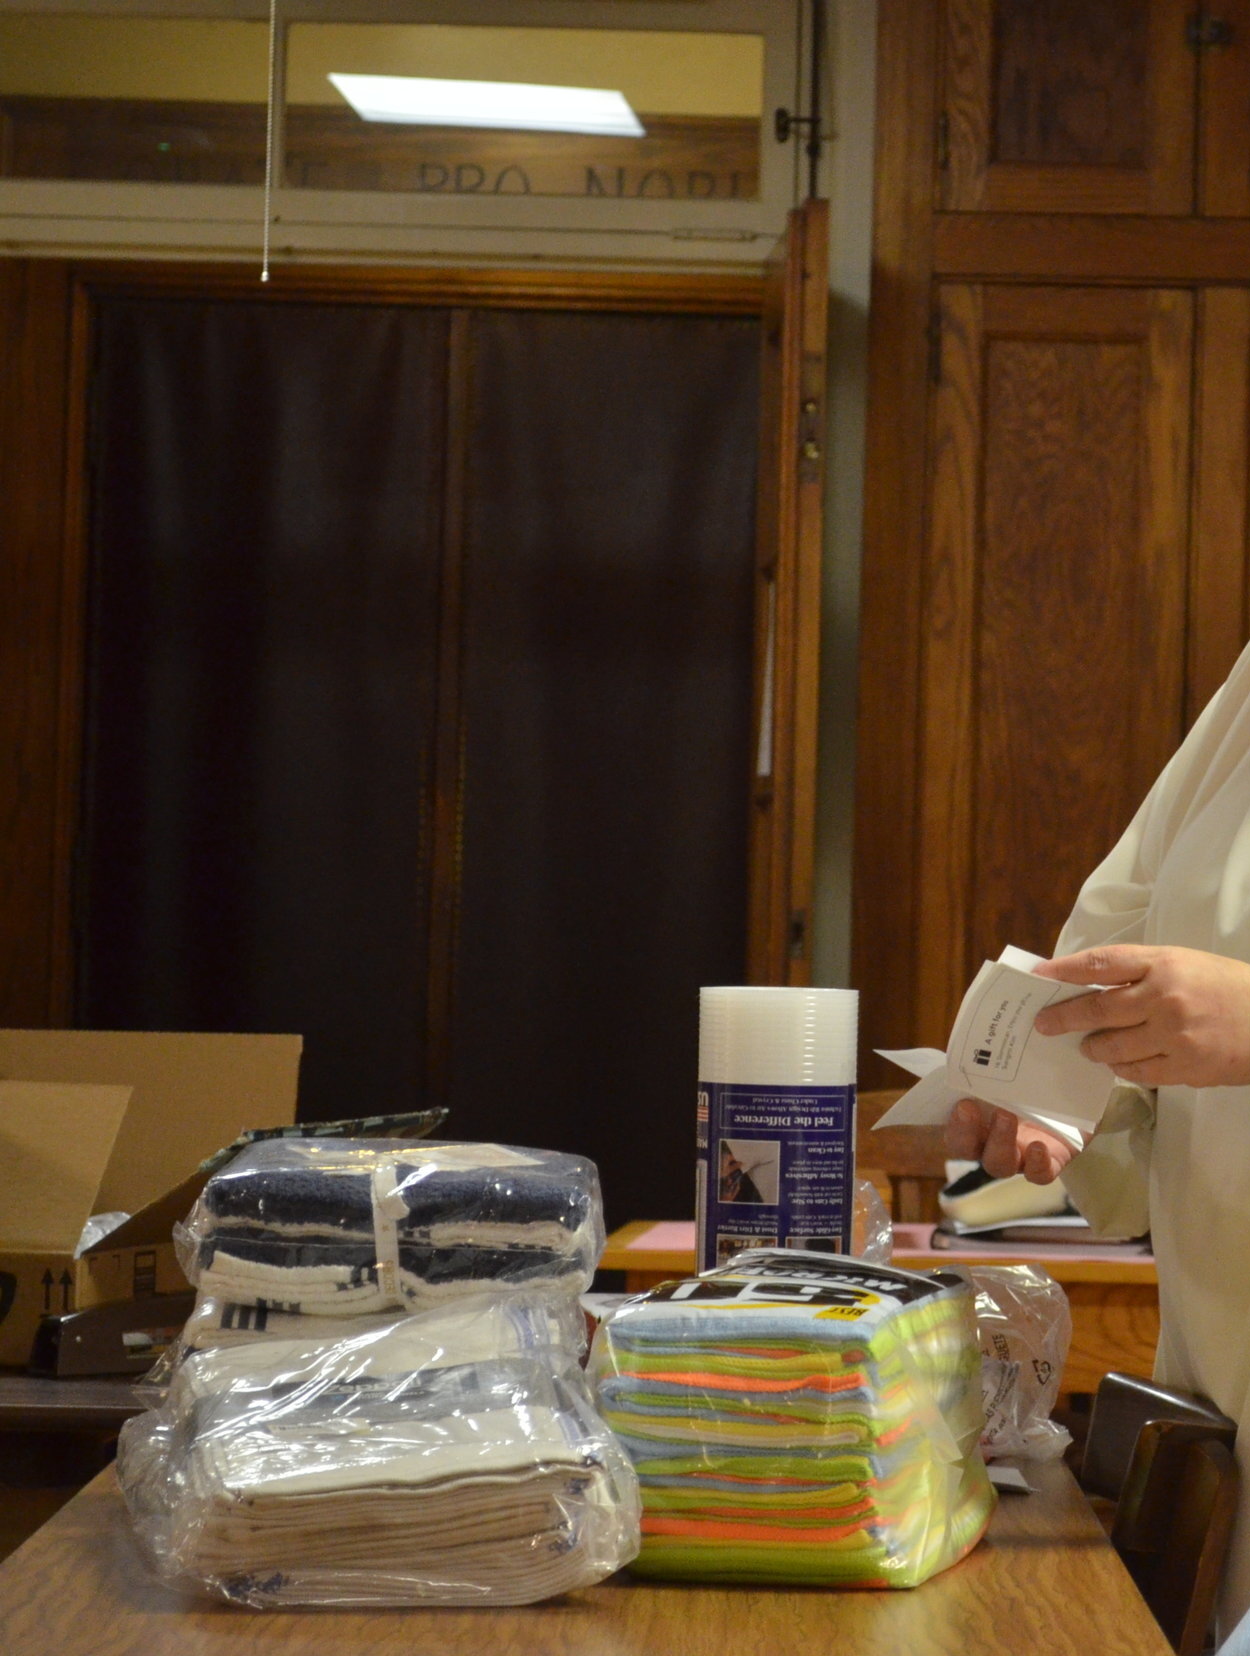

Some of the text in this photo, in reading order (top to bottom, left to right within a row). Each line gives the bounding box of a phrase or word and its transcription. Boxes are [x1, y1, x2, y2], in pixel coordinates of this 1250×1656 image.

[992, 1012, 1002, 1023] for
[988, 1023, 998, 1038] gift
[788, 1105, 809, 1113] Design
[734, 1114, 834, 1127] Feel the Difference
[785, 1172, 818, 1180] Adhesives
[789, 1226, 814, 1234] Surface
